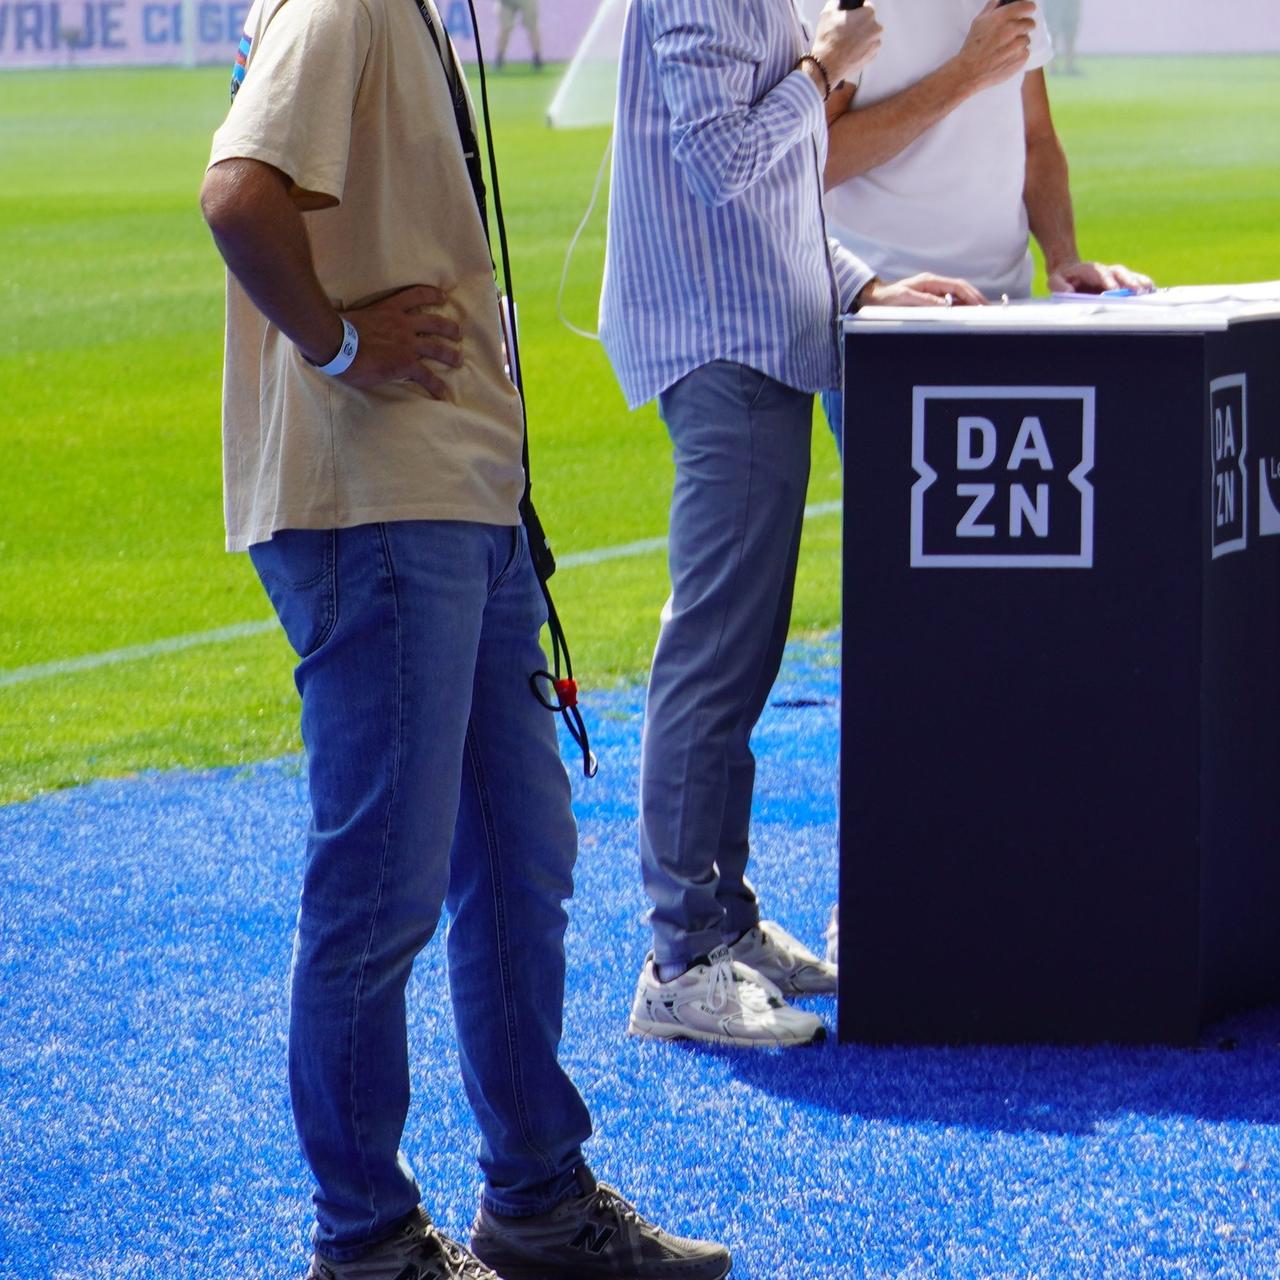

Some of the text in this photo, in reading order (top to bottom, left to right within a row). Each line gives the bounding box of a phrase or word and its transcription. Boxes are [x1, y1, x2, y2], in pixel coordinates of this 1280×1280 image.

[957, 416, 1053, 470] DA
[1215, 404, 1235, 461] DA
[956, 483, 1049, 538] ZN
[1216, 470, 1235, 528] ZN
